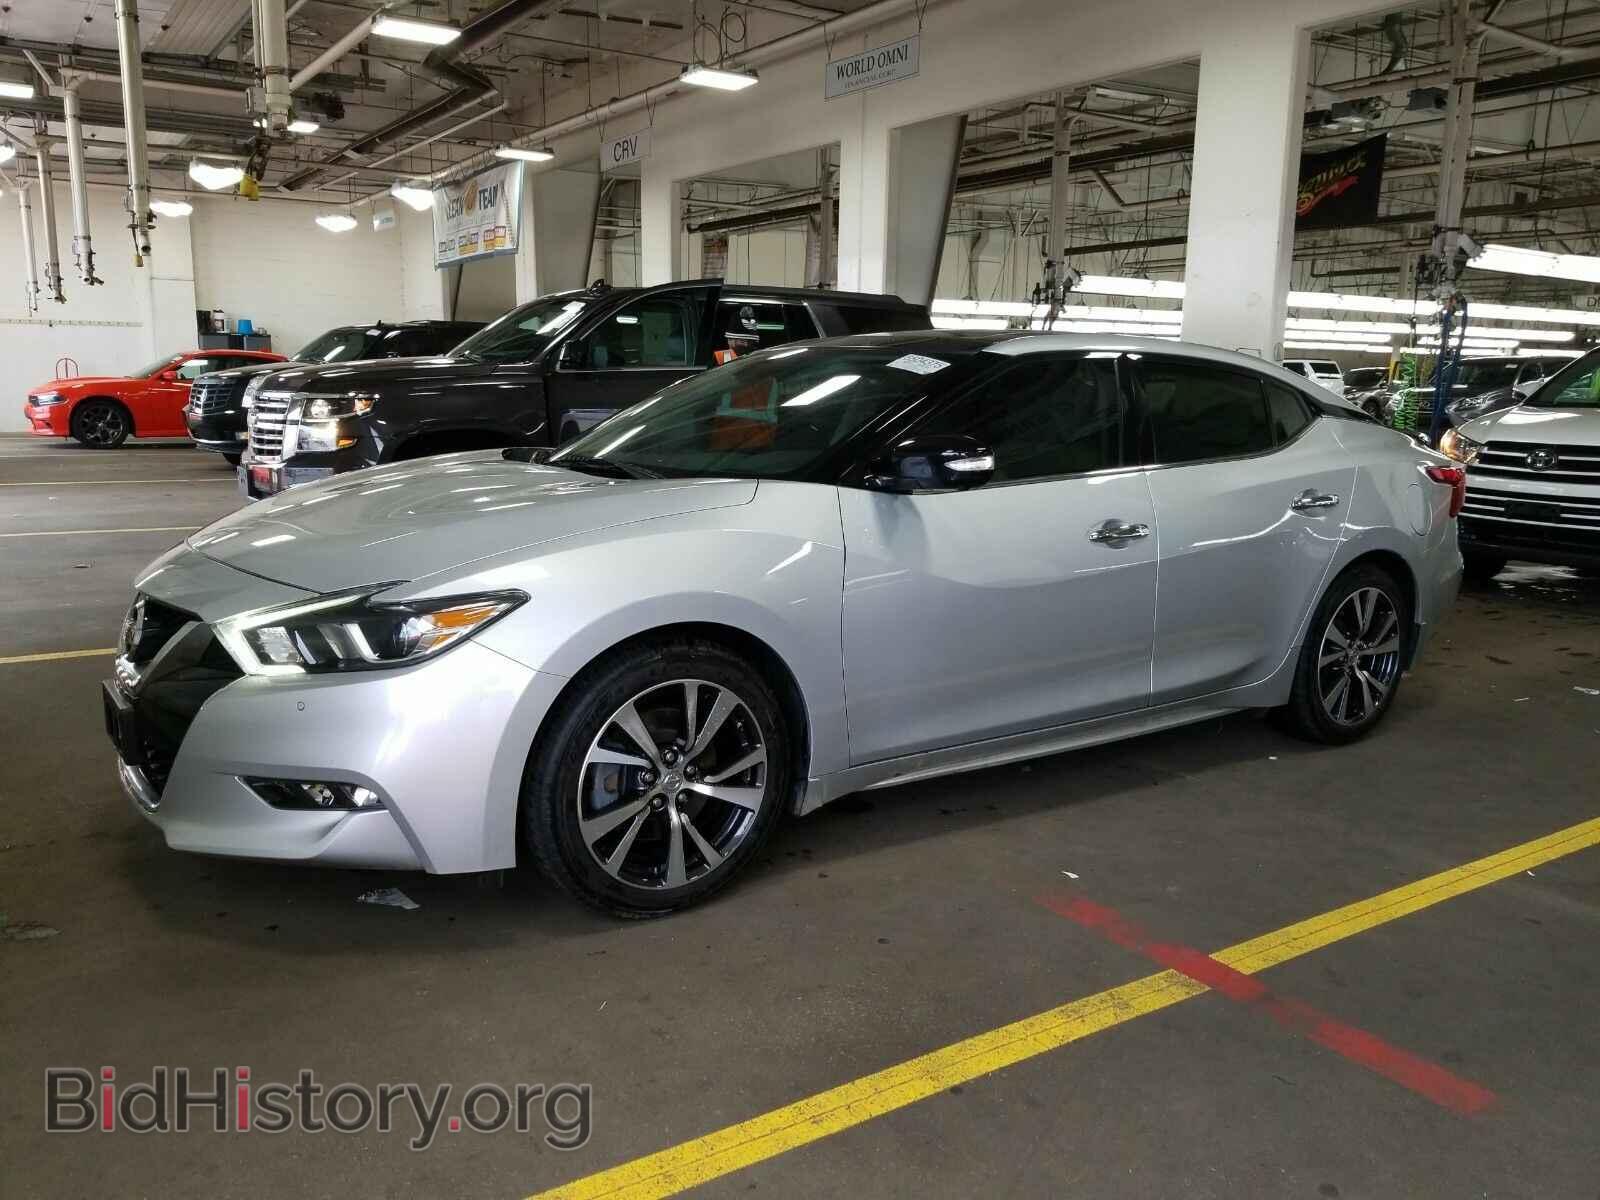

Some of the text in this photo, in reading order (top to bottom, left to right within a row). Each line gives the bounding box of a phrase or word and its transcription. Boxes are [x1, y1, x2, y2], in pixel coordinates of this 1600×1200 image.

[837, 44, 909, 80] WORLD OMNI
[613, 135, 638, 162] CRV
